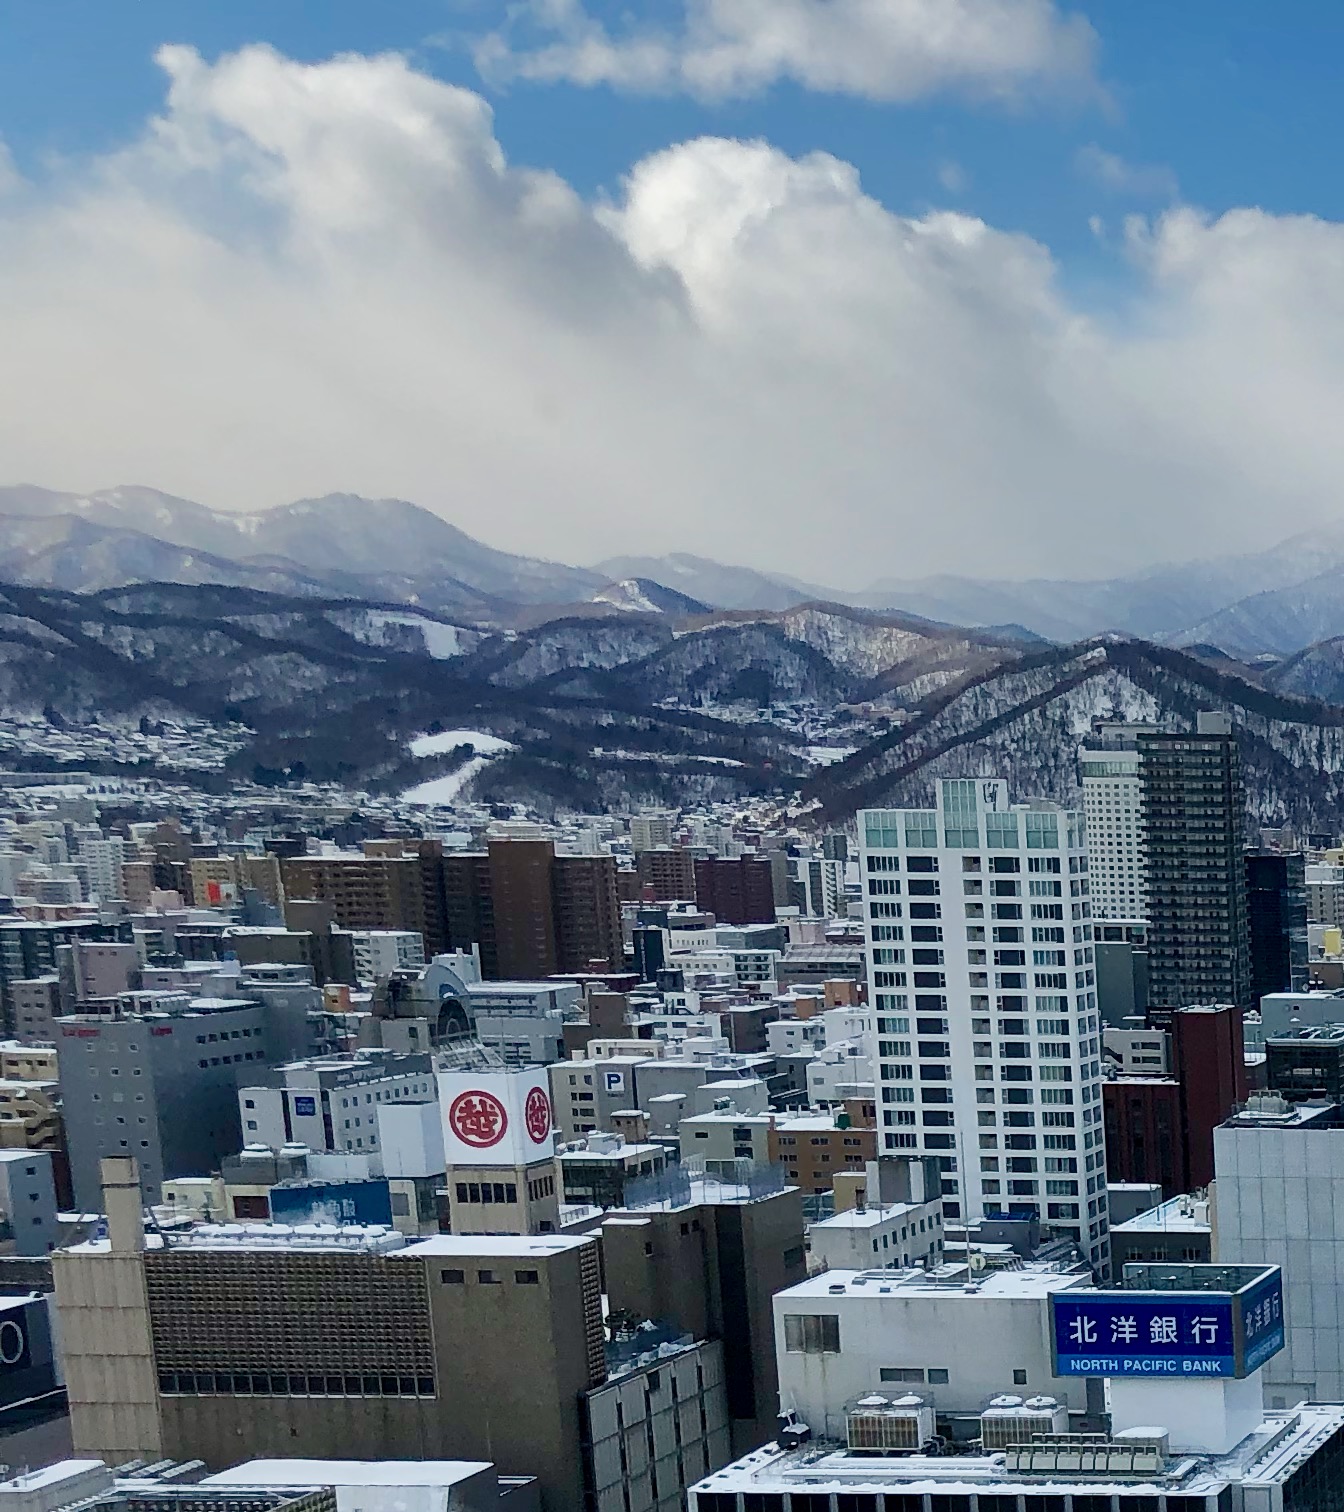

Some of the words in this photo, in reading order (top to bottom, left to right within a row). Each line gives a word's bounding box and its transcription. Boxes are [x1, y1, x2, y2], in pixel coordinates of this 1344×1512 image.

[606, 1073, 621, 1090] P
[1245, 1291, 1280, 1339] 北洋銀行
[1069, 1315, 1219, 1344] 北洋銀行
[1070, 1360, 1118, 1371] NORTH
[1124, 1360, 1177, 1371] PACIFIC
[1183, 1360, 1222, 1372] BANK
